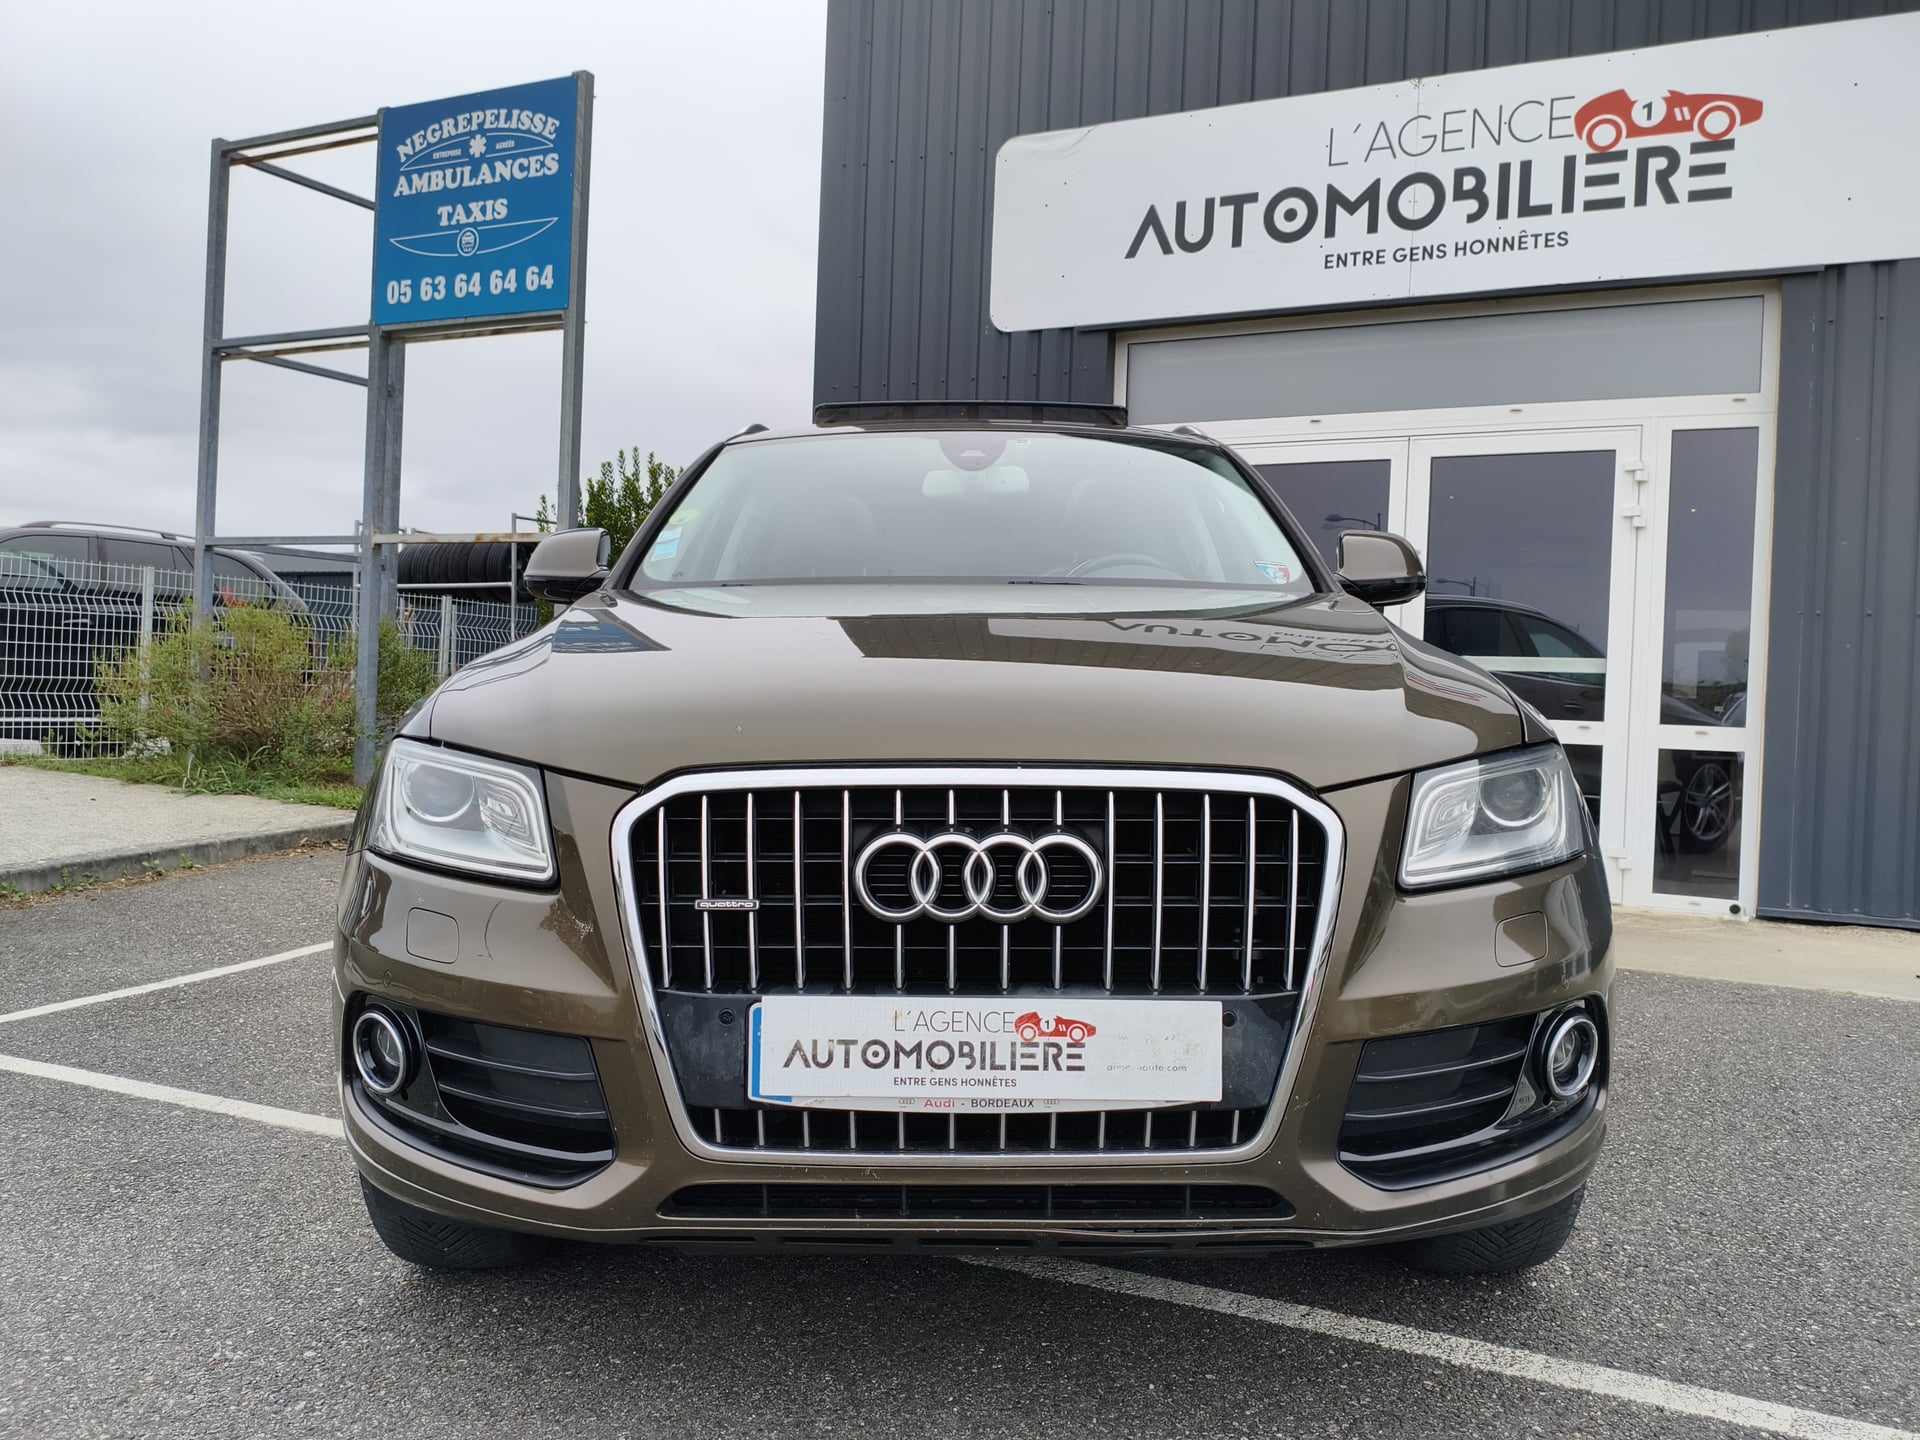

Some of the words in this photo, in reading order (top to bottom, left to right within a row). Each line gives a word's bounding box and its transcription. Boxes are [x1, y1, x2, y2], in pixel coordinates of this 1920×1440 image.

[396, 109, 560, 163] NEGREPELISSE
[1328, 96, 1575, 167] L'AGENCE
[393, 153, 559, 197] AMBULANCES
[437, 198, 508, 226] TAXIS
[1324, 249, 1386, 269] ENTRE
[1392, 243, 1448, 263] GENS
[1454, 229, 1569, 258] HONNÊTES
[386, 279, 412, 304] 05
[420, 275, 446, 301] 63
[454, 272, 481, 298] 64
[489, 268, 517, 295] 64
[525, 264, 554, 291] 64
[894, 1010, 1015, 1033] L'AGENCE
[893, 1077, 926, 1086] ENTRE
[929, 1077, 958, 1086] GENS
[960, 1076, 1017, 1087] HONNÊTES
[924, 1098, 955, 1108] Audi
[971, 1098, 1035, 1108] BORDEAUX
